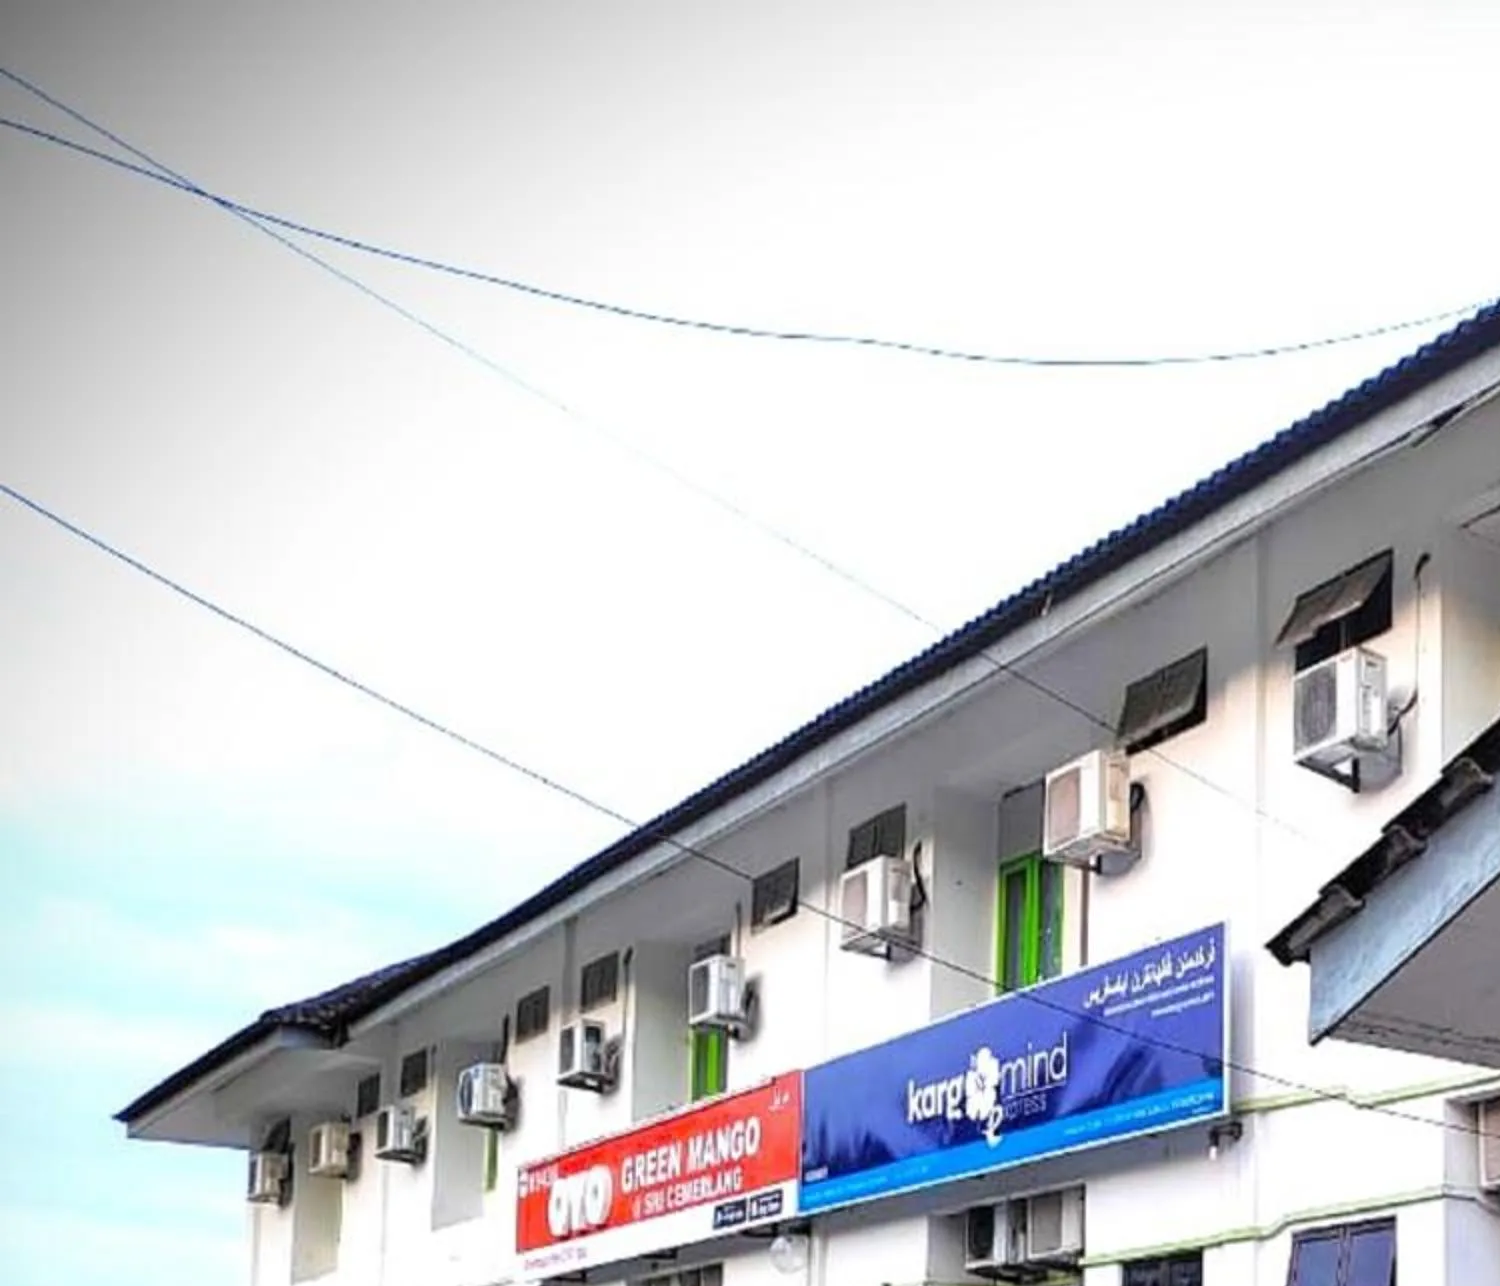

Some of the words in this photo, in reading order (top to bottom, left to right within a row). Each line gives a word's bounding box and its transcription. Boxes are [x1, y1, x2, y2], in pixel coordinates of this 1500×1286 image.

[621, 1139, 683, 1194] GREEN
[687, 1116, 761, 1174] MANGO
[548, 1165, 613, 1237] OYO
